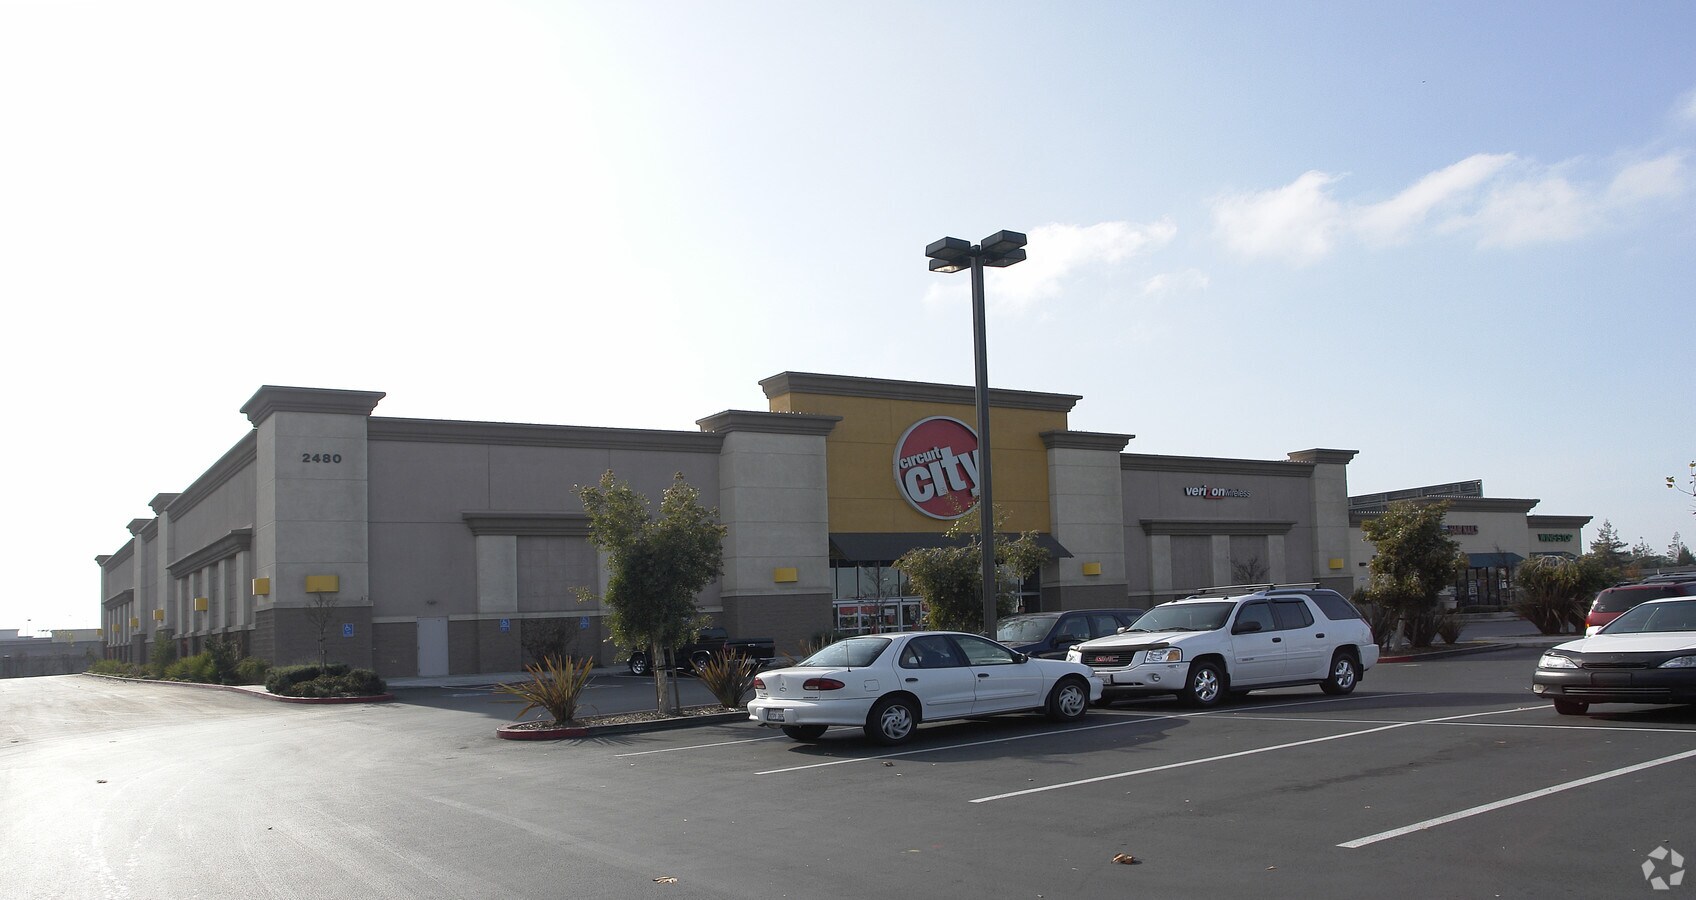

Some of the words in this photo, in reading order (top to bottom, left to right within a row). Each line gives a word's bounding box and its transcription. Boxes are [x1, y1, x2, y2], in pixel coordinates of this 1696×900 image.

[302, 453, 342, 464] 2480
[900, 446, 942, 469] circuit
[905, 446, 980, 503] city
[1184, 484, 1225, 500] verizon
